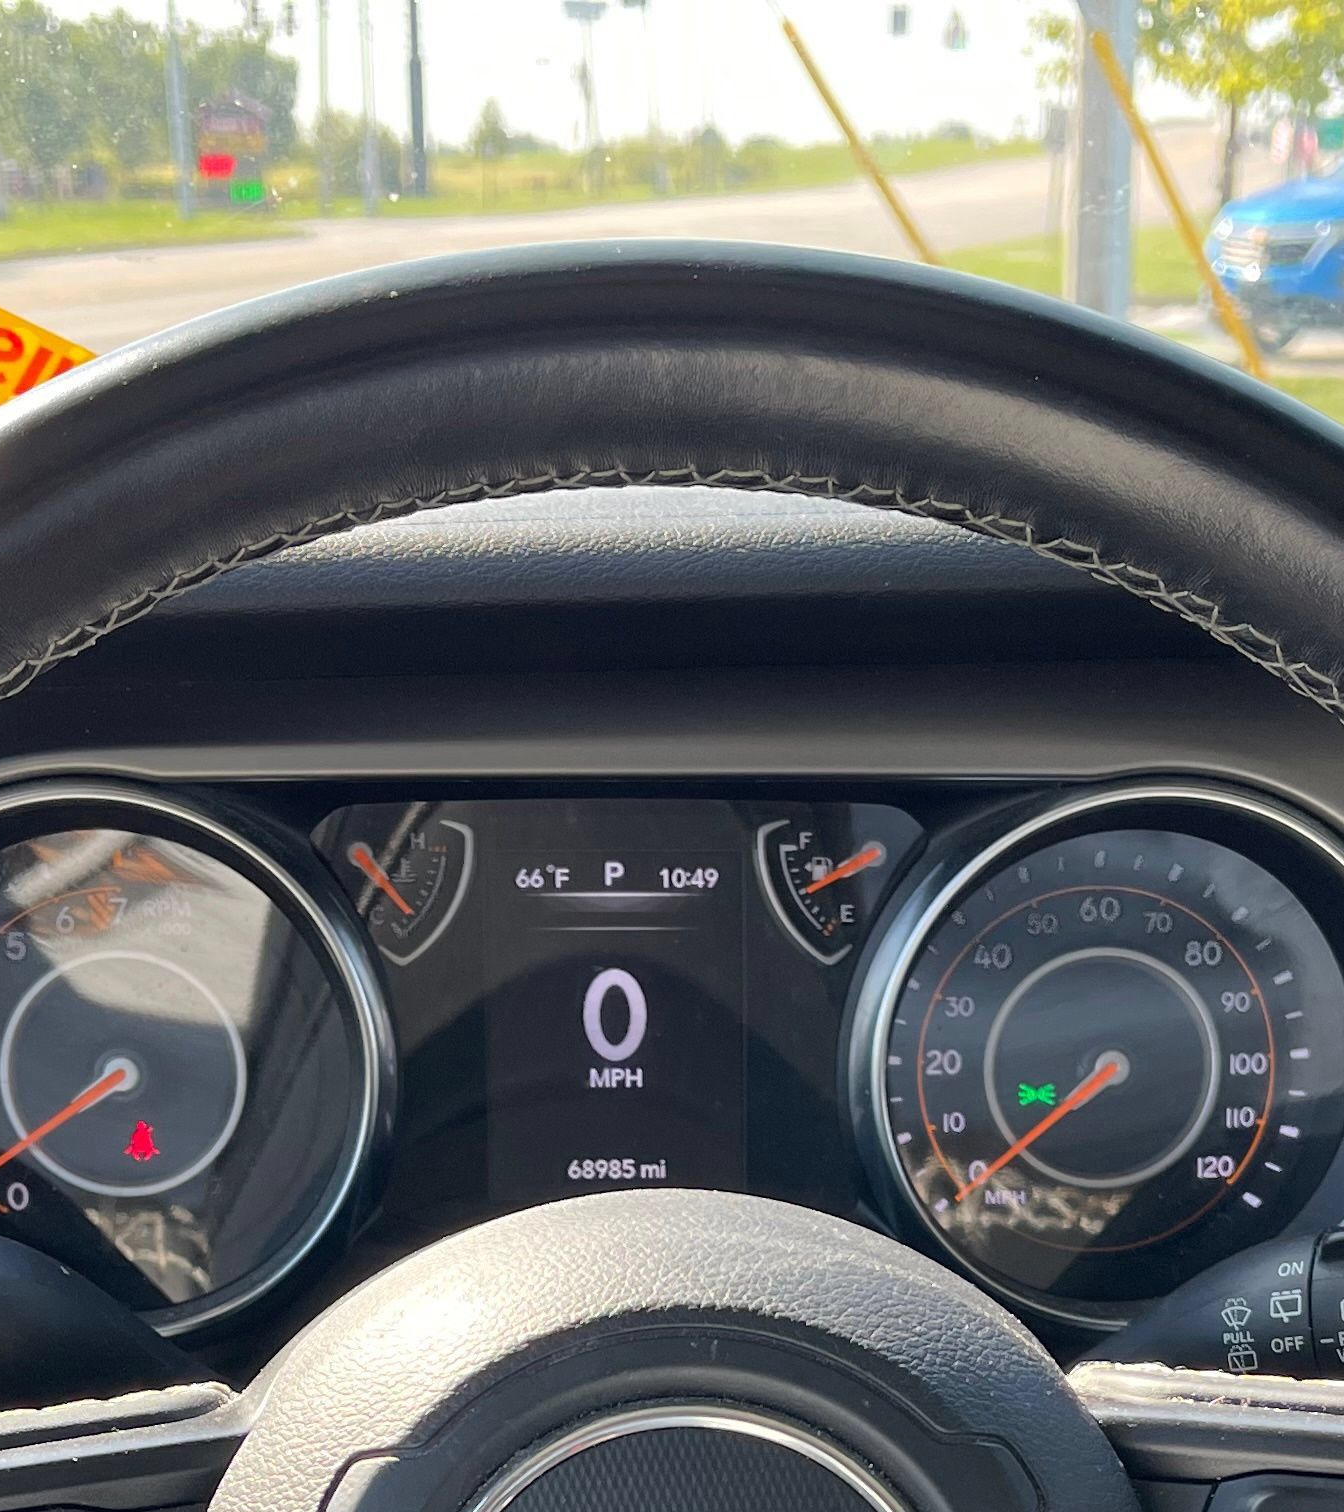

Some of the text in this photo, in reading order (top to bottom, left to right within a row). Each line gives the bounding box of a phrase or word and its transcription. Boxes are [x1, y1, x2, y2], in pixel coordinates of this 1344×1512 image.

[799, 831, 813, 848] F
[515, 862, 719, 890] 66°F P 10:49
[56, 906, 75, 934] 6
[841, 906, 854, 922] E
[1078, 898, 1122, 922] 60
[1028, 913, 1058, 934] 50
[1144, 913, 1172, 934] 70
[4, 932, 28, 961] 5
[973, 944, 1012, 969] 40
[1184, 942, 1222, 966] 80
[944, 996, 974, 1018] 30
[1222, 992, 1252, 1014] 90
[582, 967, 648, 1062] 0
[926, 1051, 961, 1075] 20
[1230, 1052, 1267, 1076] 100
[589, 1068, 644, 1088] MPH
[942, 1112, 966, 1133] 10
[1225, 1108, 1255, 1129] 110
[568, 1158, 666, 1181] 68985 mi
[1197, 1156, 1234, 1180] 120
[6, 1181, 30, 1211] 0
[984, 1190, 1027, 1205] MPH
[1278, 1261, 1304, 1277] ON
[1222, 1331, 1255, 1345] PULL
[1271, 1336, 1304, 1353] OFF
